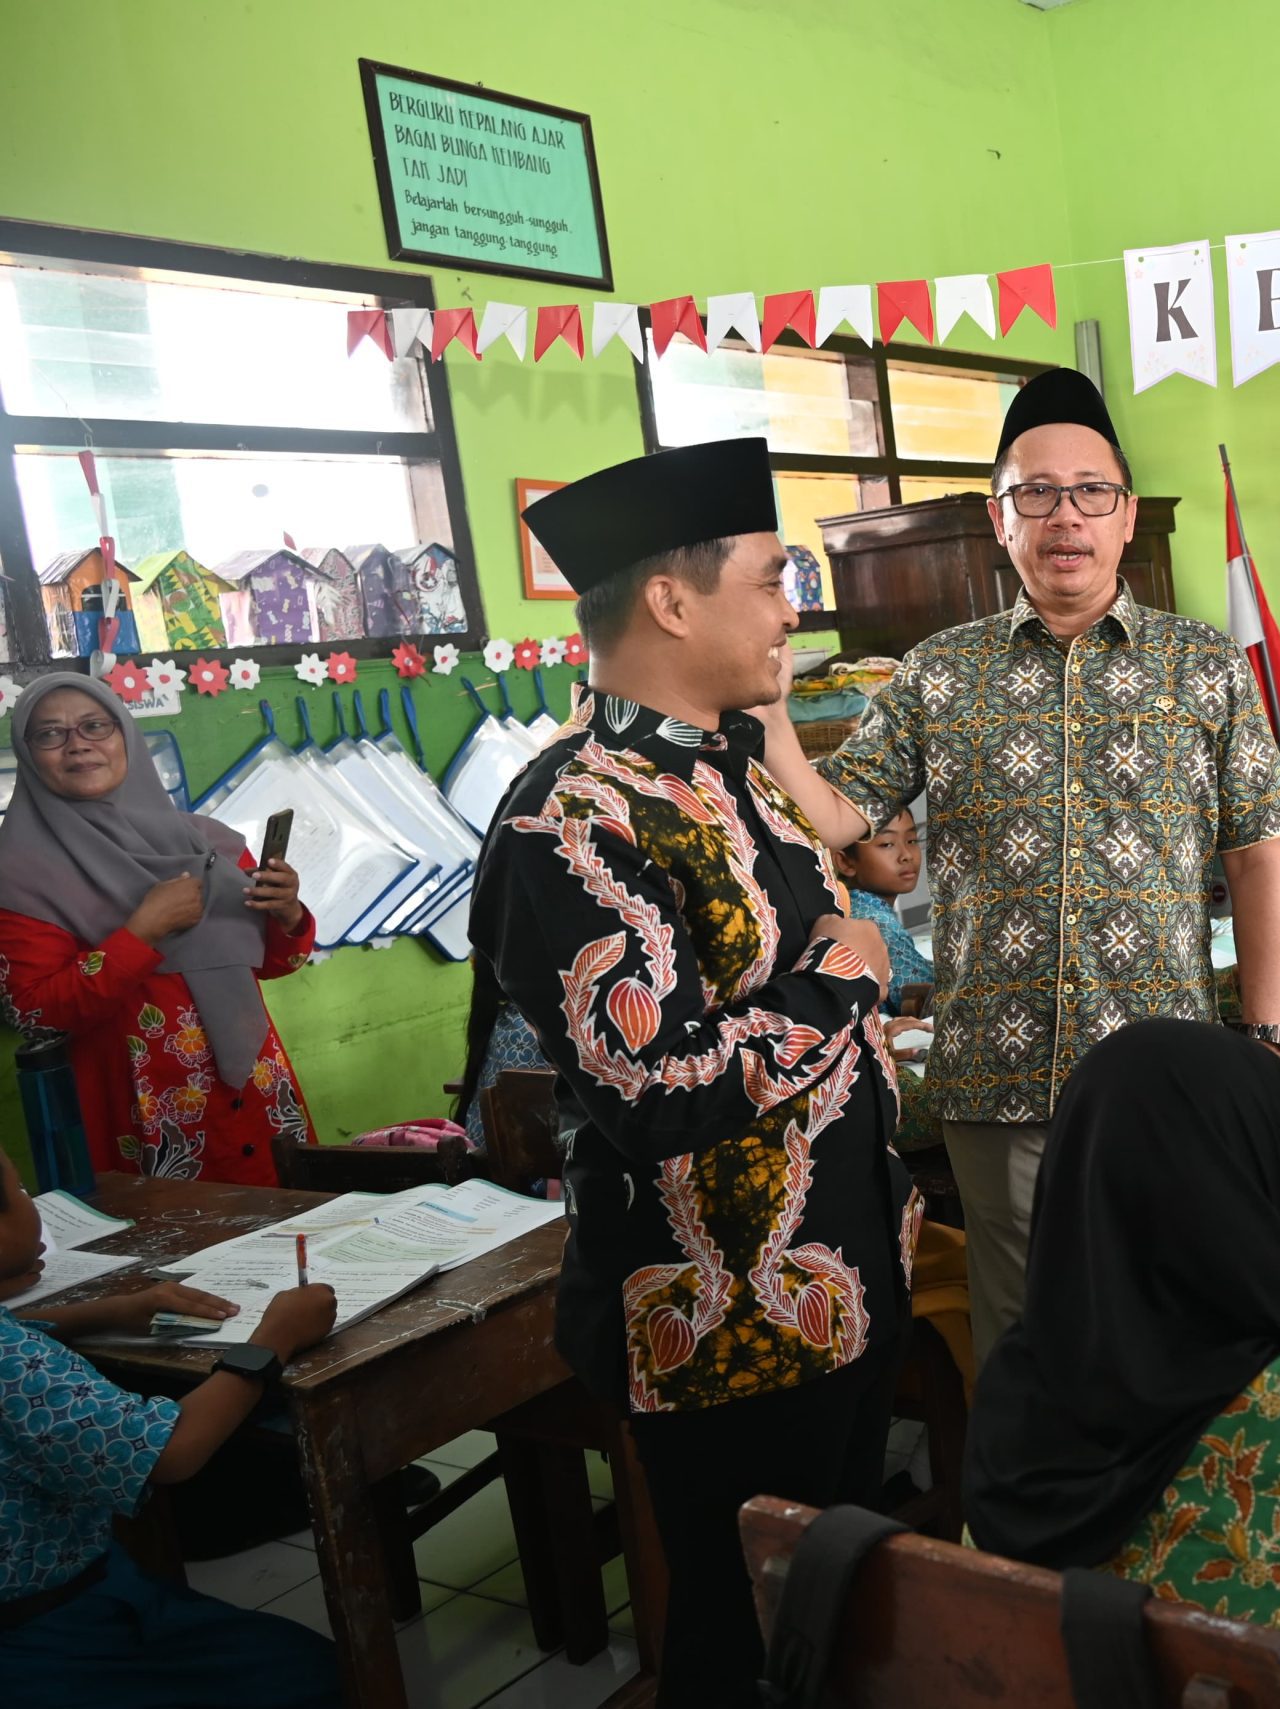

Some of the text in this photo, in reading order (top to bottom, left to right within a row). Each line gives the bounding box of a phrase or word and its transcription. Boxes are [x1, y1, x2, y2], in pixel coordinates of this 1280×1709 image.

[389, 92, 566, 150] BERGURU KEPALANG AJAR
[394, 124, 551, 175] BAGAI BUNGA KEMBANG
[402, 157, 468, 187] TAK JADI
[405, 189, 458, 213] Belajarlah
[411, 218, 449, 238] jangan
